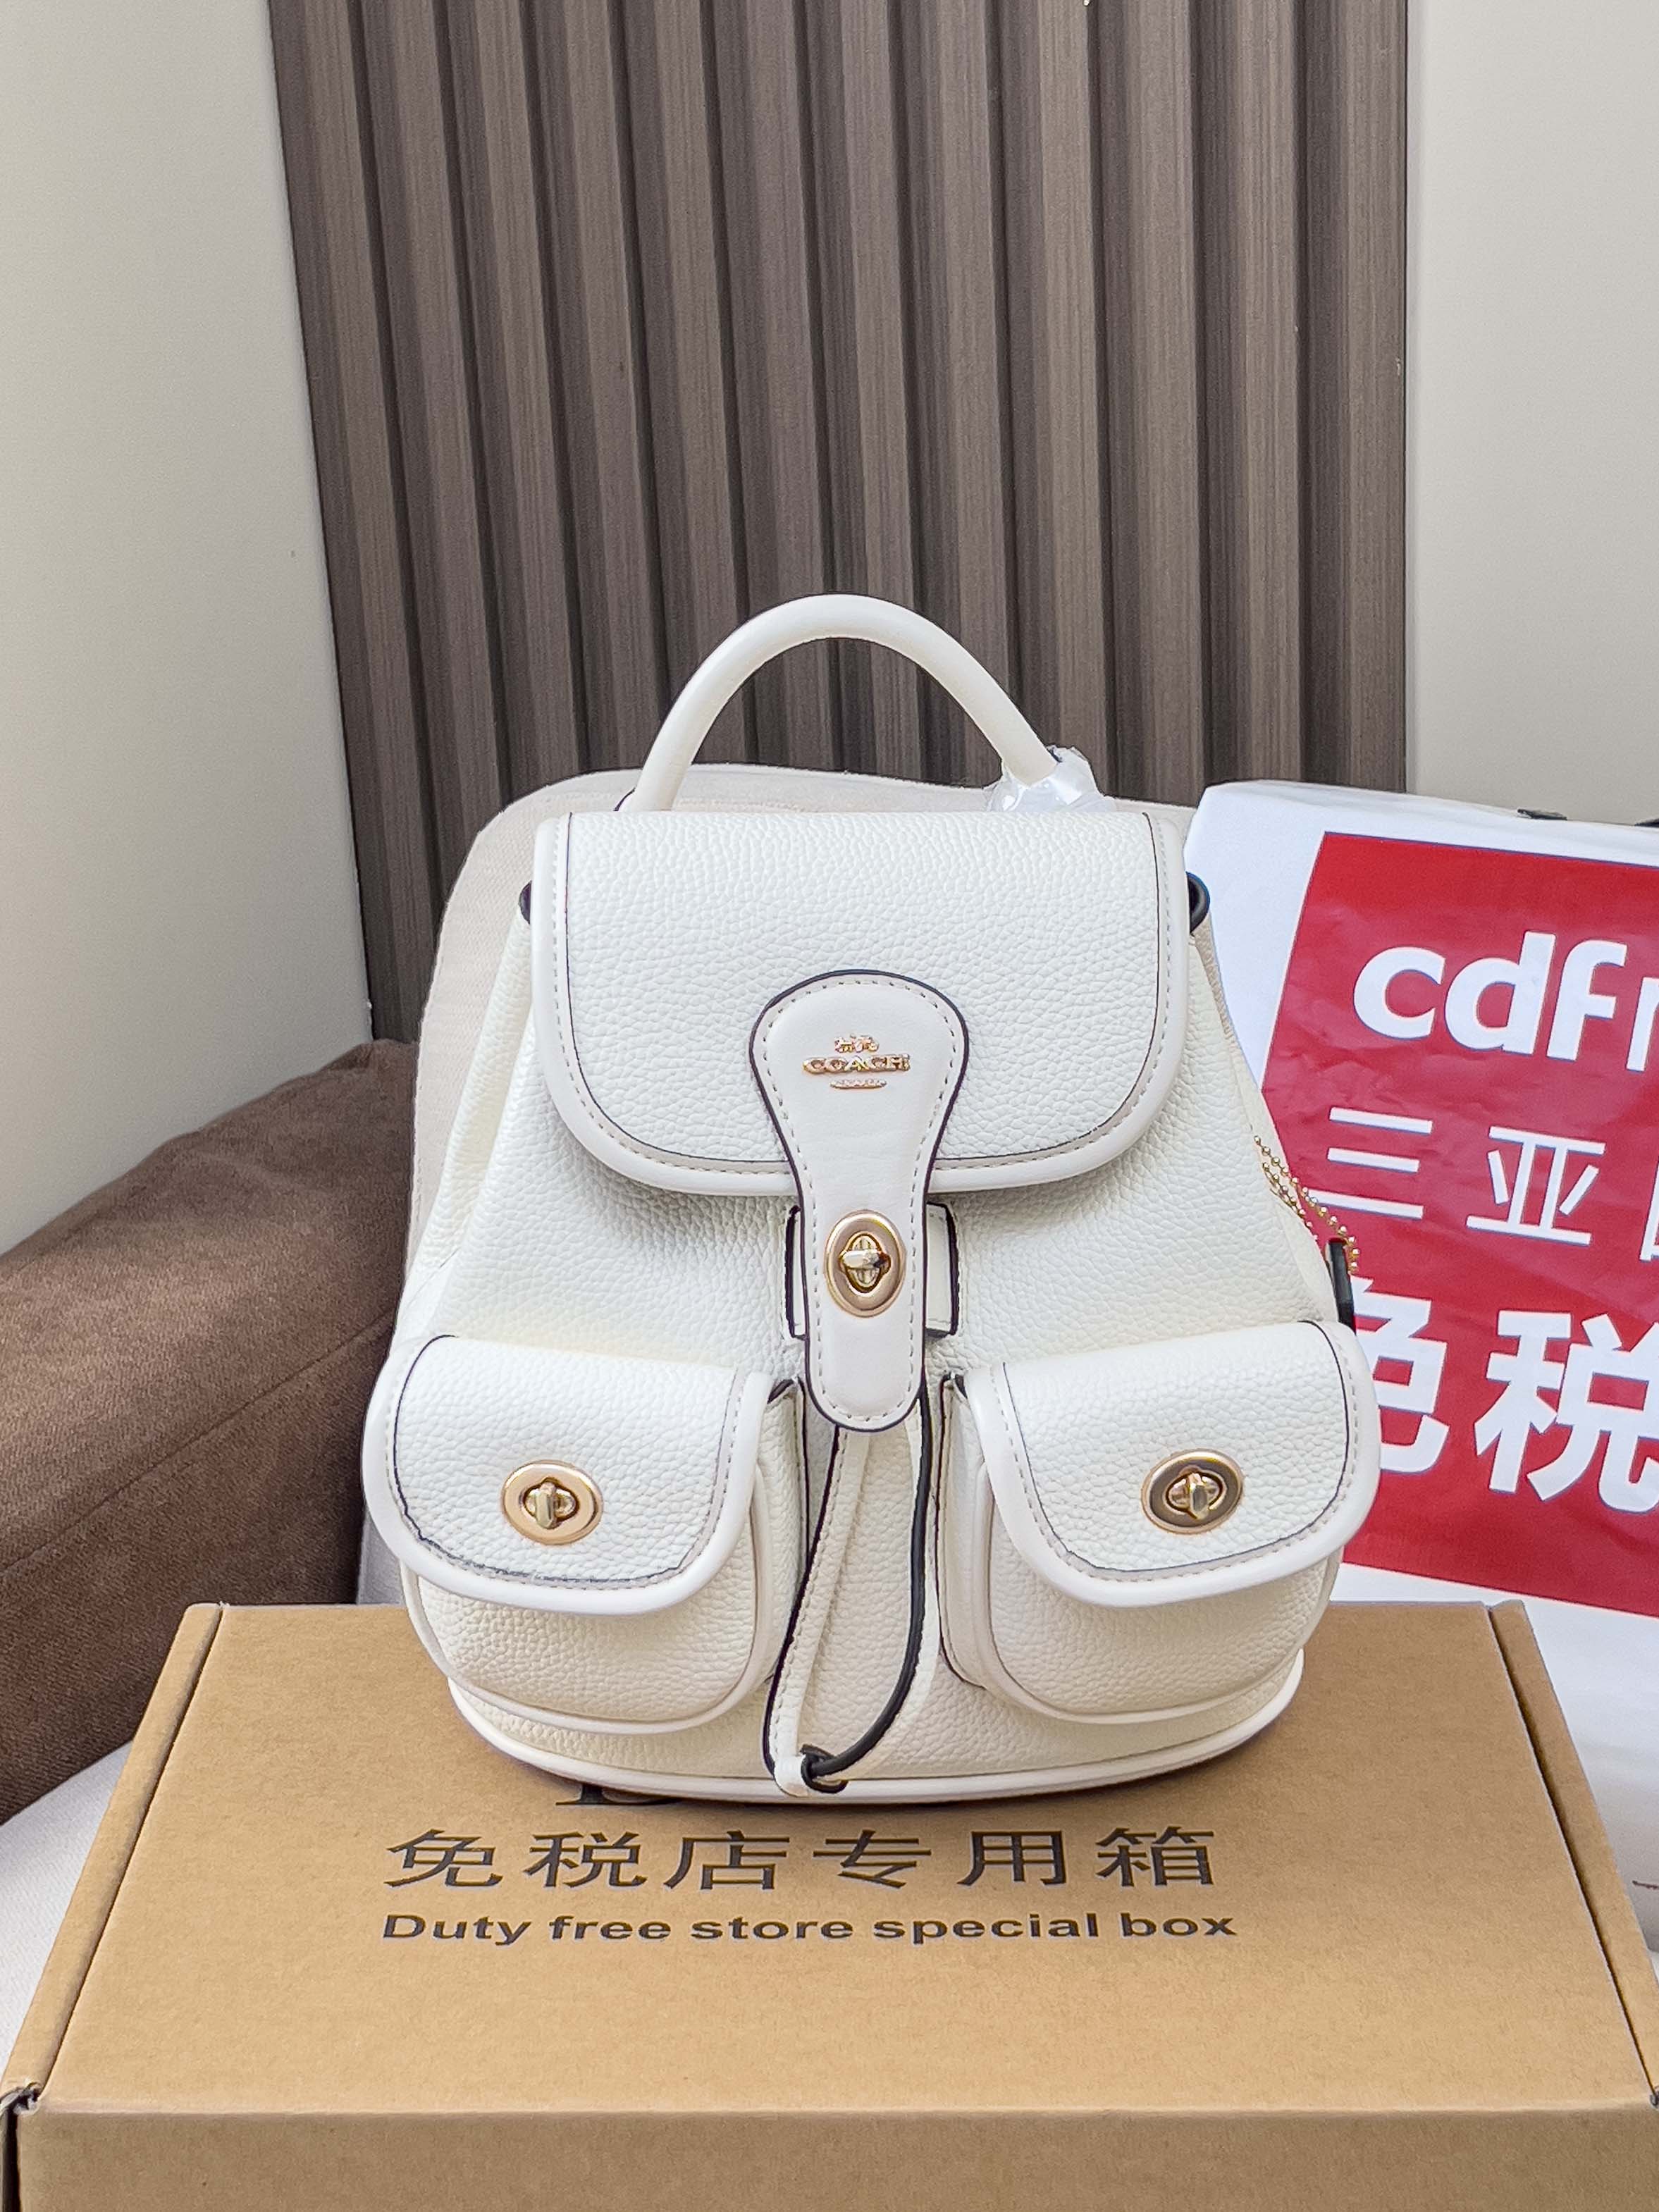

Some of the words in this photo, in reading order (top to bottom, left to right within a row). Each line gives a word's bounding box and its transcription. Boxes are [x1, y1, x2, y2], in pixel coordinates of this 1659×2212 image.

[1353, 931, 1659, 1073] cdf
[803, 1053, 911, 1074] COACH
[1303, 1107, 1659, 1261] 三亚
[383, 1827, 1215, 1890] 免税店专用箱
[382, 1914, 531, 1946] Duty
[549, 1915, 672, 1940] free
[690, 1916, 853, 1940] store
[872, 1912, 1099, 1945] special
[1120, 1912, 1238, 1938] box
